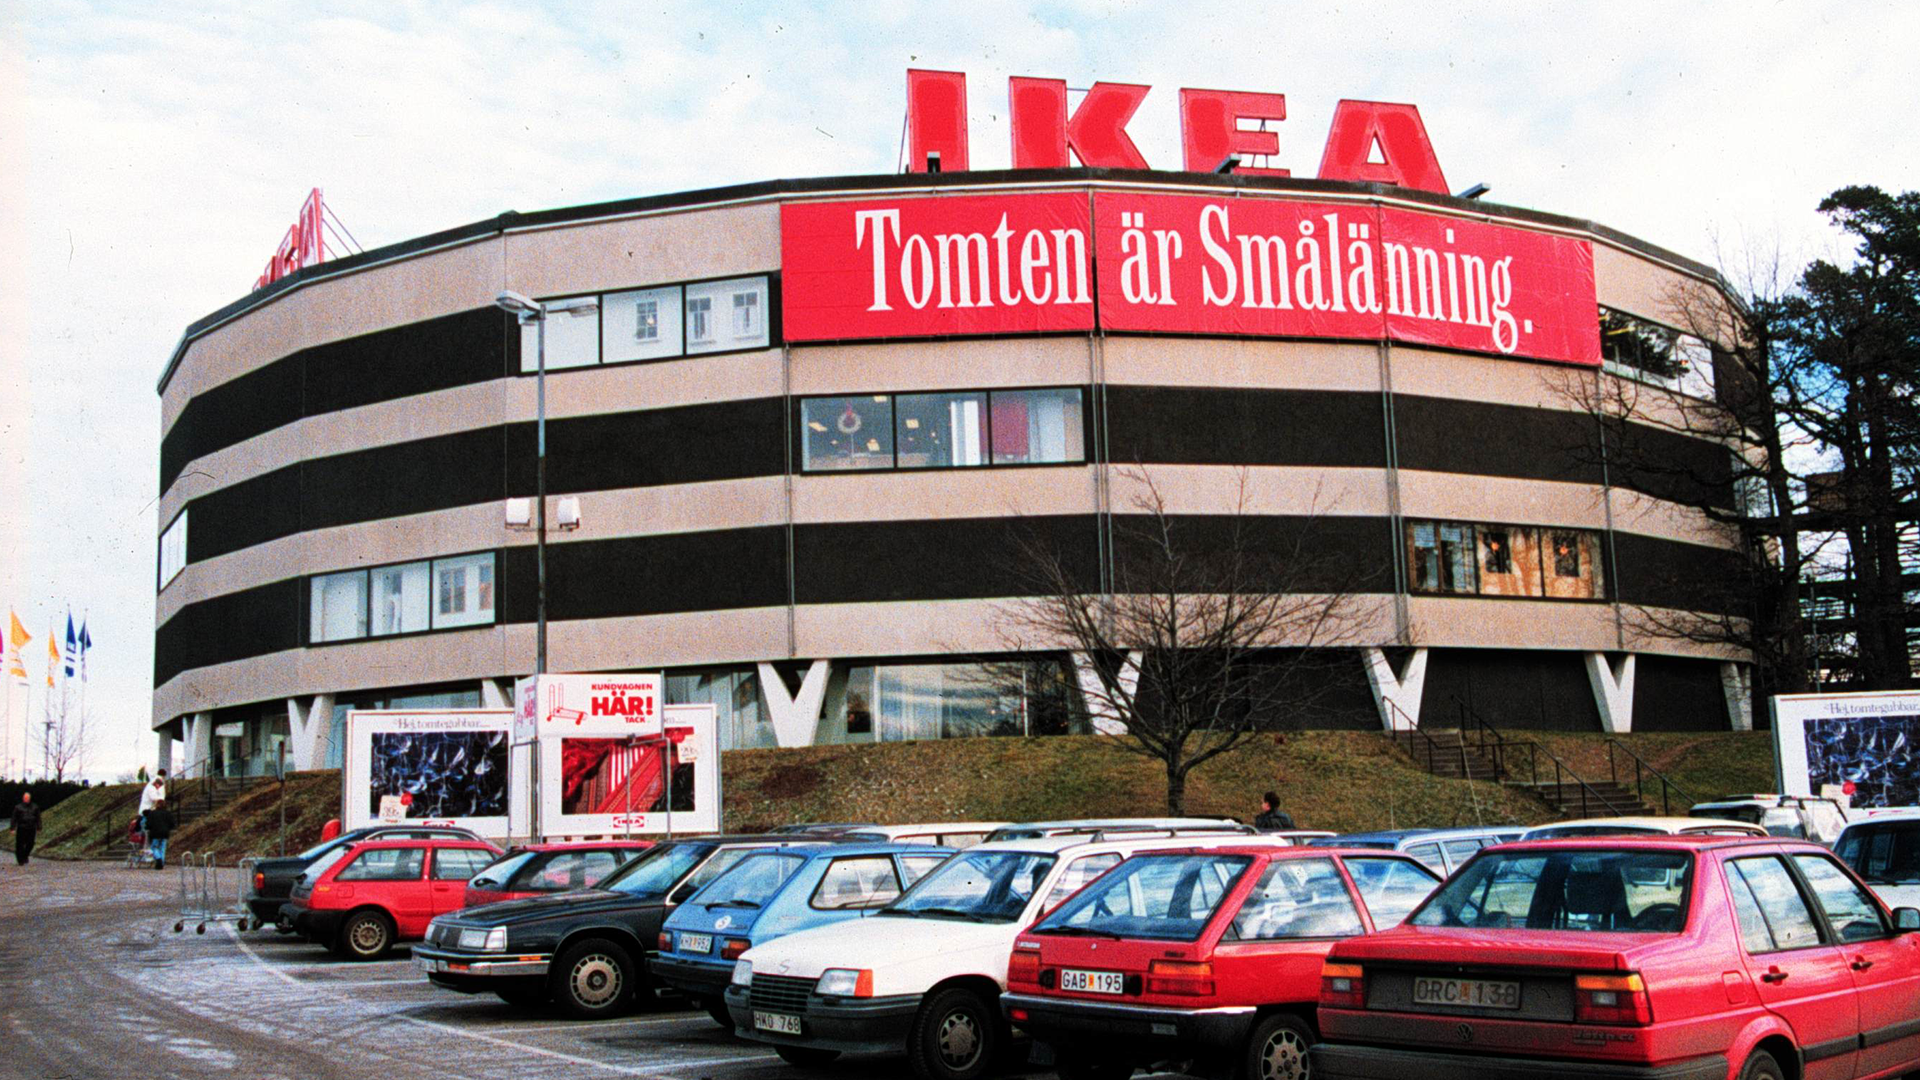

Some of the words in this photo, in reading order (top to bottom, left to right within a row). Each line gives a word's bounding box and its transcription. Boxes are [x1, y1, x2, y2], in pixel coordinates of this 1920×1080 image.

[907, 68, 1450, 195] IKEA
[855, 208, 1092, 311] Tomten
[1121, 212, 1183, 305] är
[1199, 204, 1533, 353] Smålänning.
[591, 690, 653, 716] HÄR!
[1062, 972, 1087, 988] GAB
[1097, 975, 1122, 991] 195
[1475, 983, 1518, 1005] 138
[781, 1016, 800, 1032] 768
